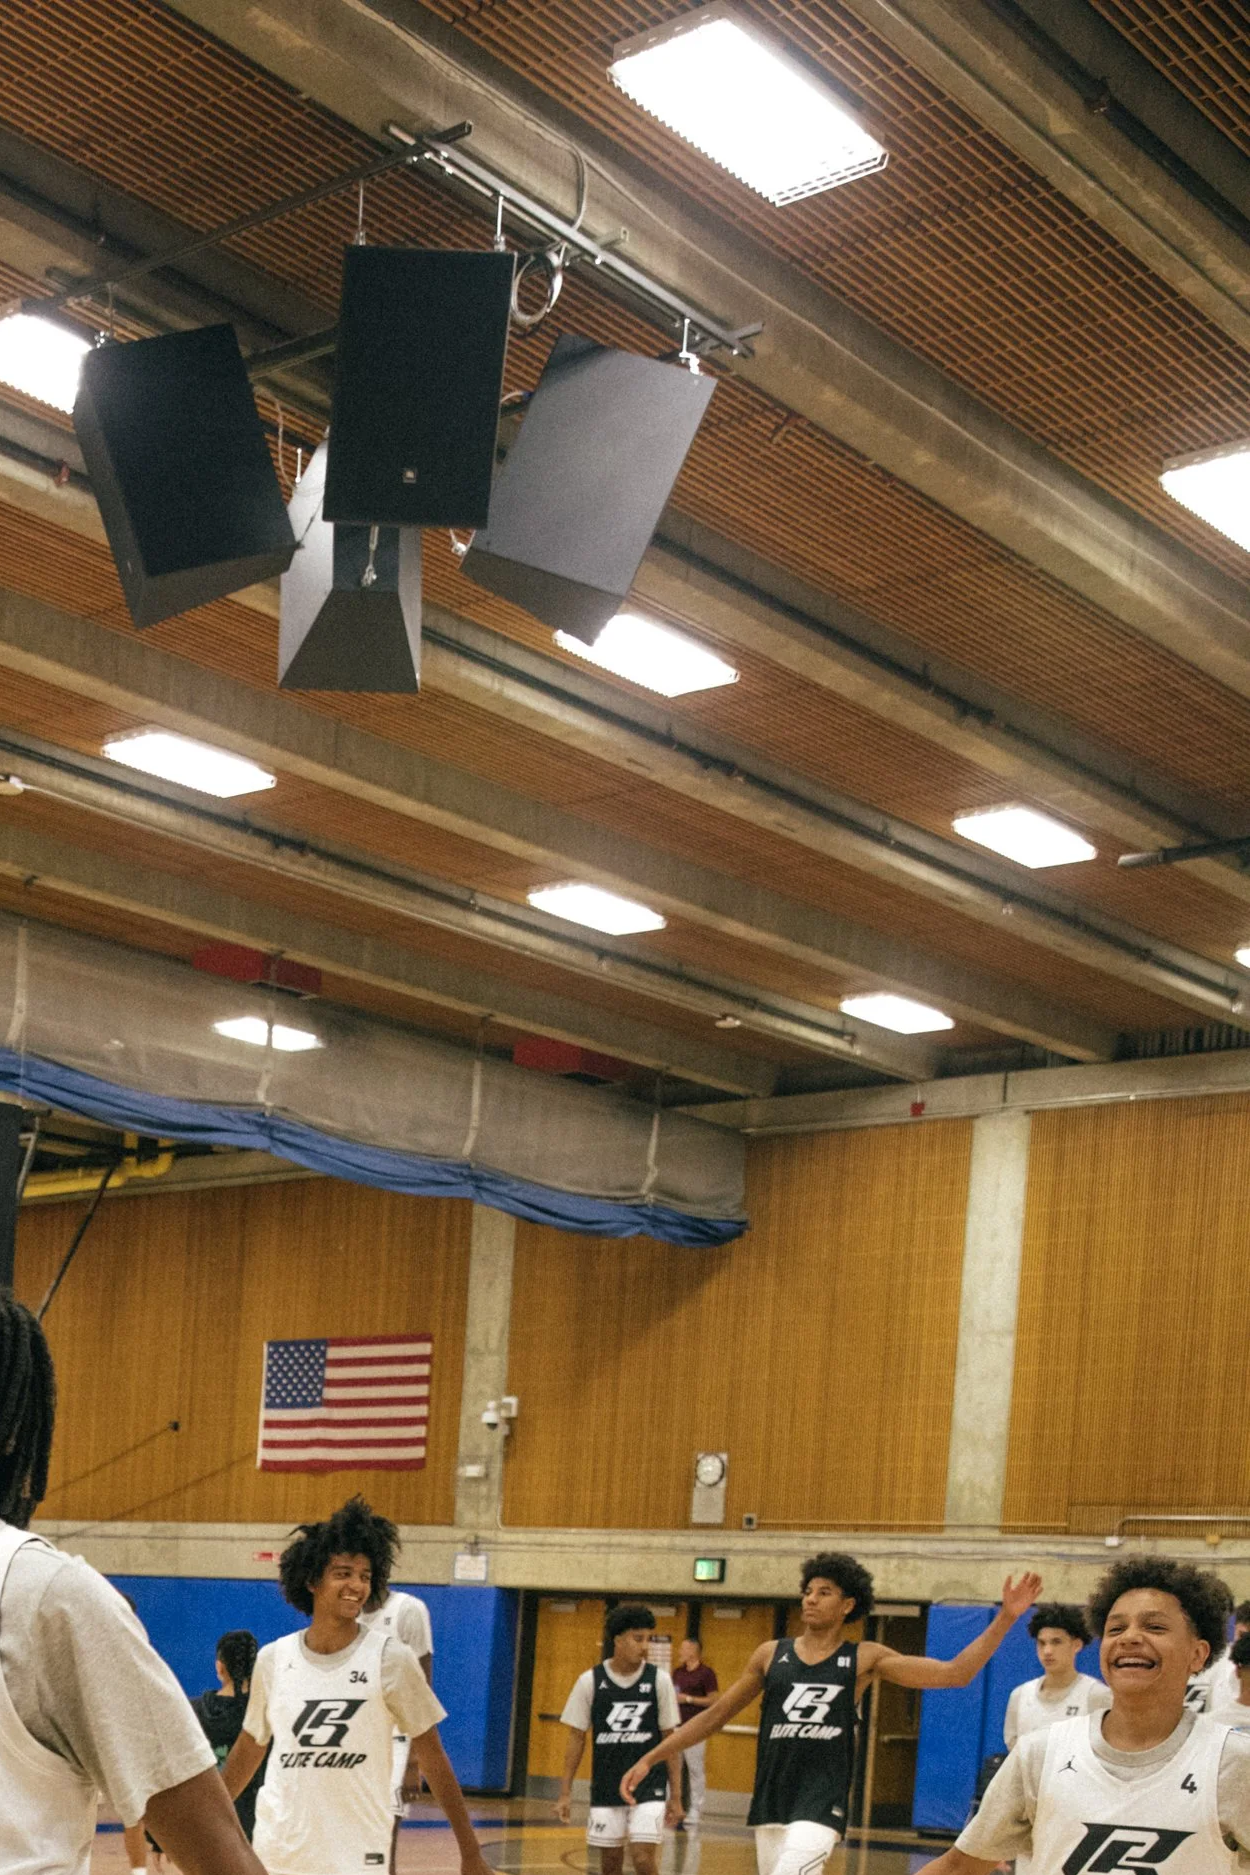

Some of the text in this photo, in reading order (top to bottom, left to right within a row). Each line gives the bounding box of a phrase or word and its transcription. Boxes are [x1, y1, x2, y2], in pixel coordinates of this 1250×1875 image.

[350, 1670, 368, 1684] 34
[1066, 1706, 1079, 1716] 27
[769, 1723, 842, 1740] ELITE CAMP
[314, 1751, 367, 1769] CAMP
[1181, 1773, 1197, 1794] 4
